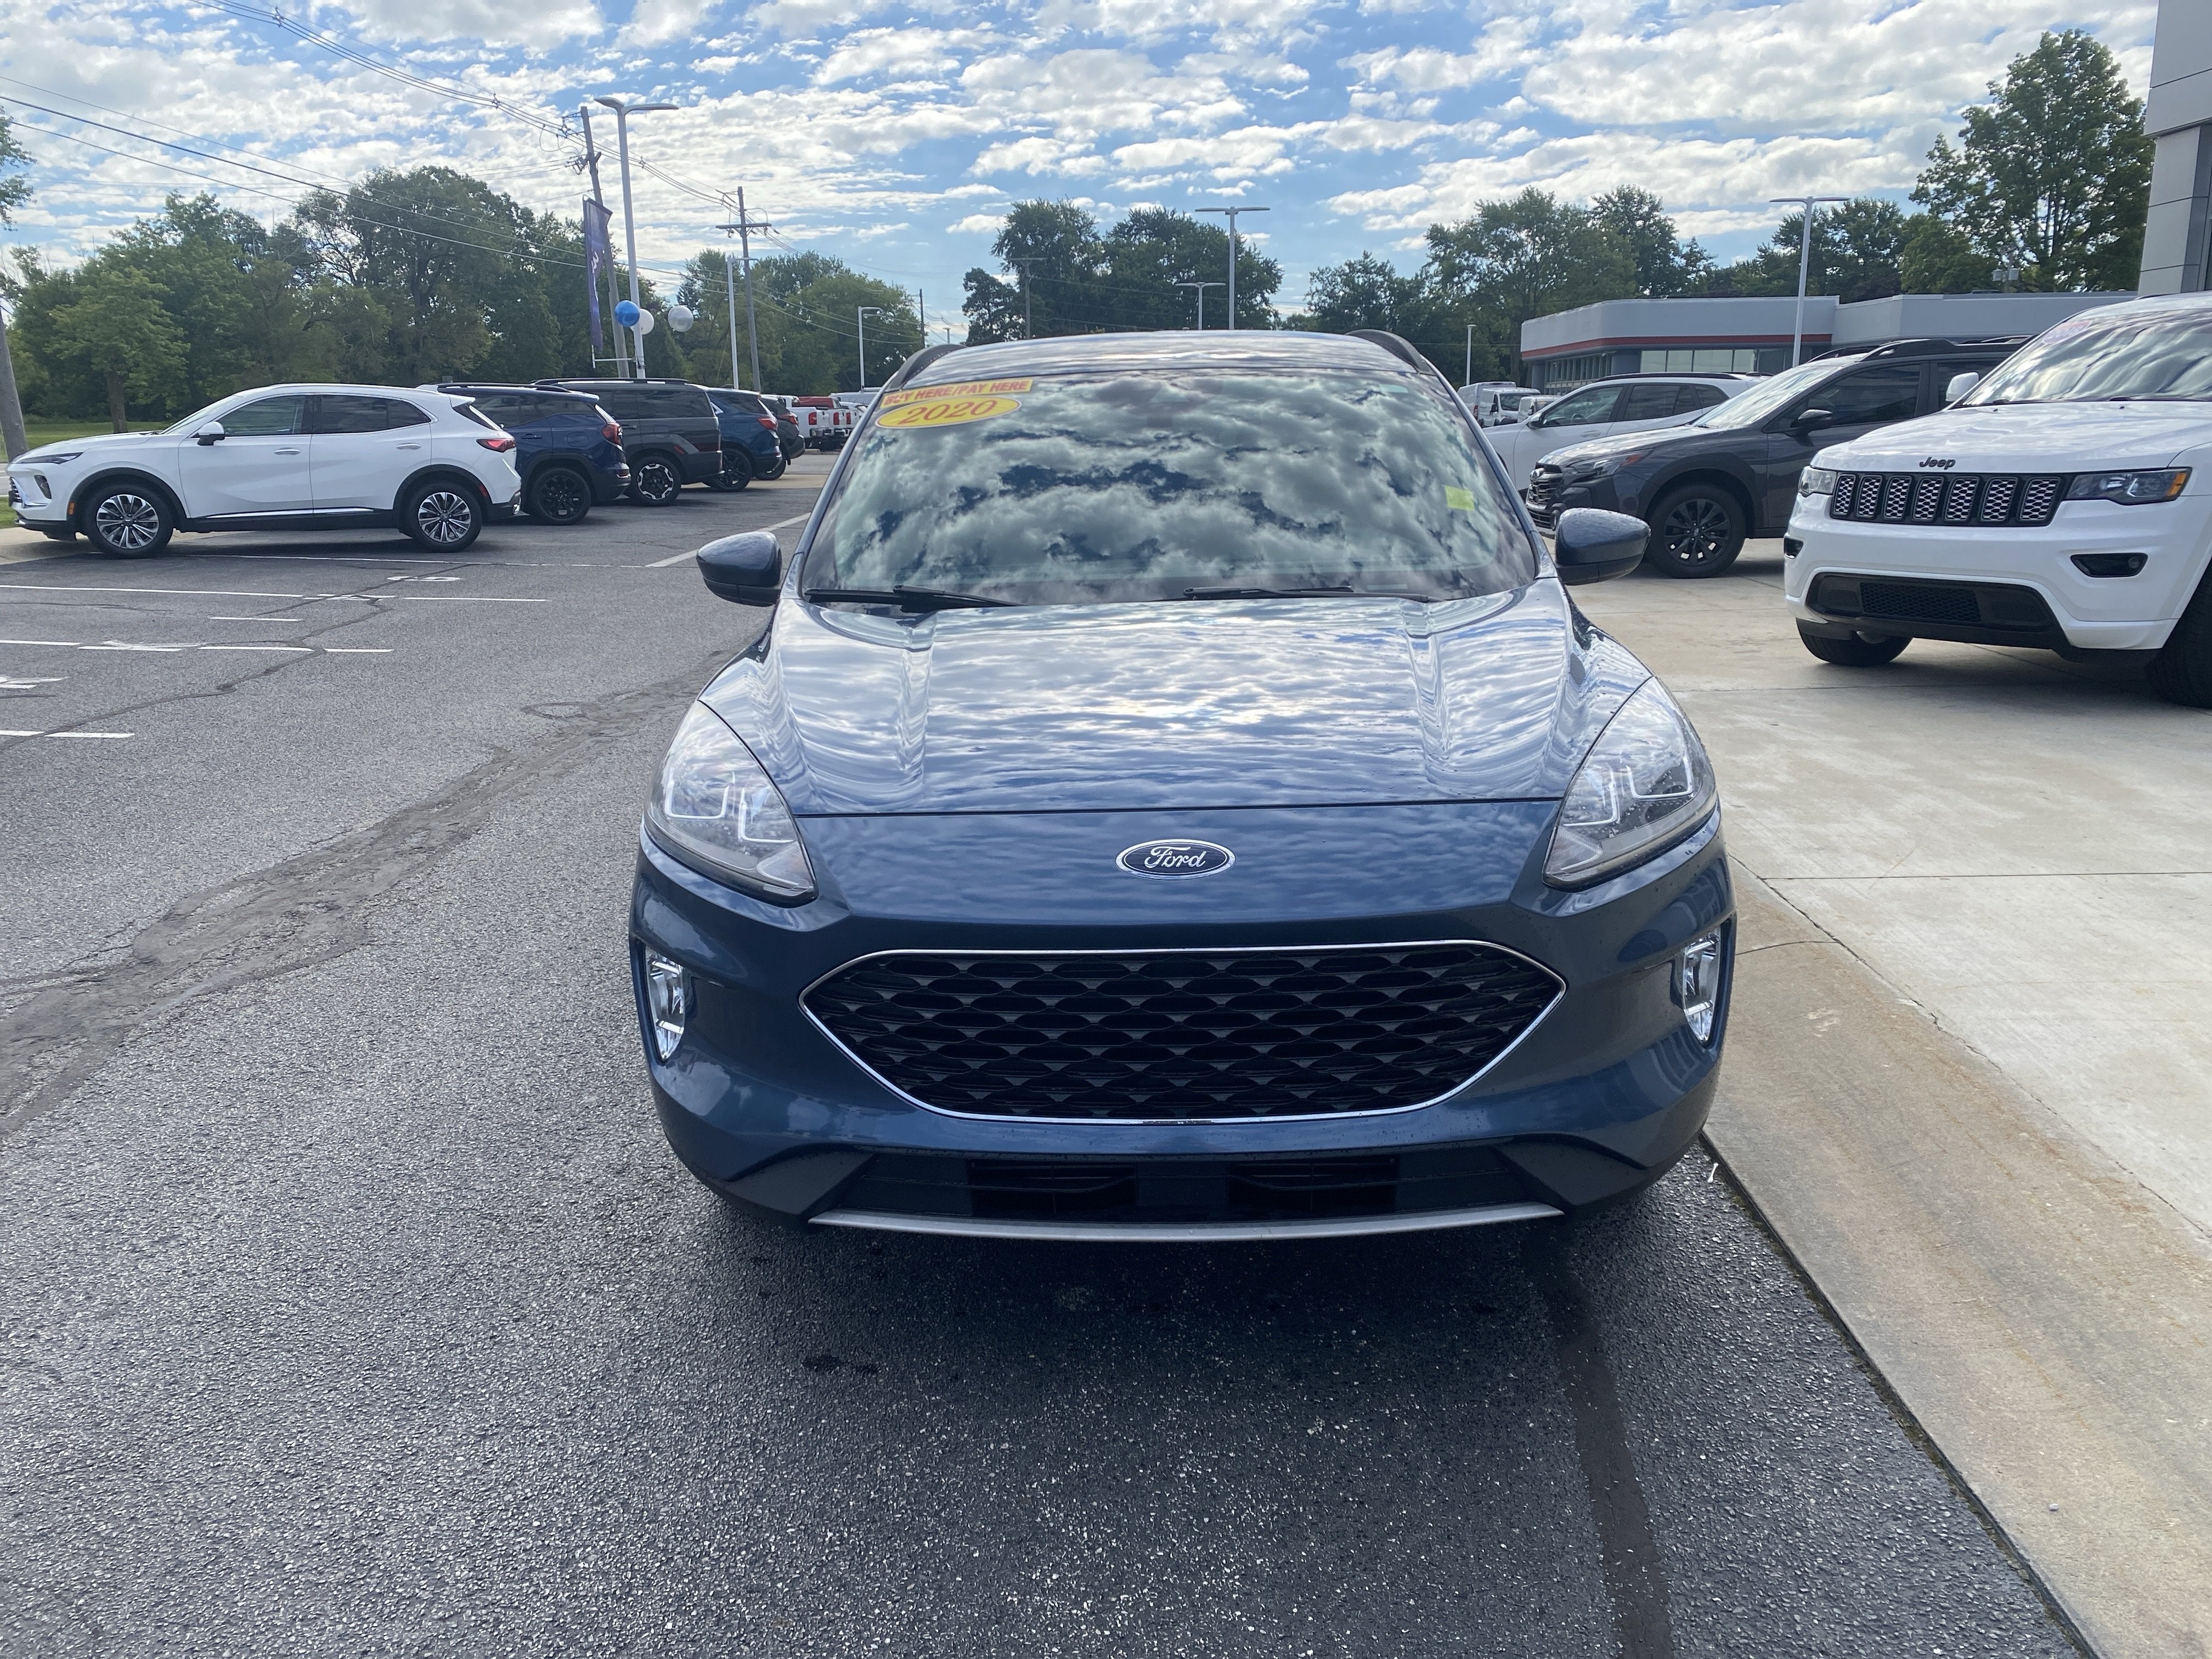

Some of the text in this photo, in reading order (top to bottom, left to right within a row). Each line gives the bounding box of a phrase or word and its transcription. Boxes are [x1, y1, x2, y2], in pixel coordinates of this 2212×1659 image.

[884, 381, 1029, 405] BUY HERE/PAY HERE
[898, 399, 998, 425] 2020
[1919, 456, 1956, 470] Jeep
[1144, 847, 1207, 868] Ford
